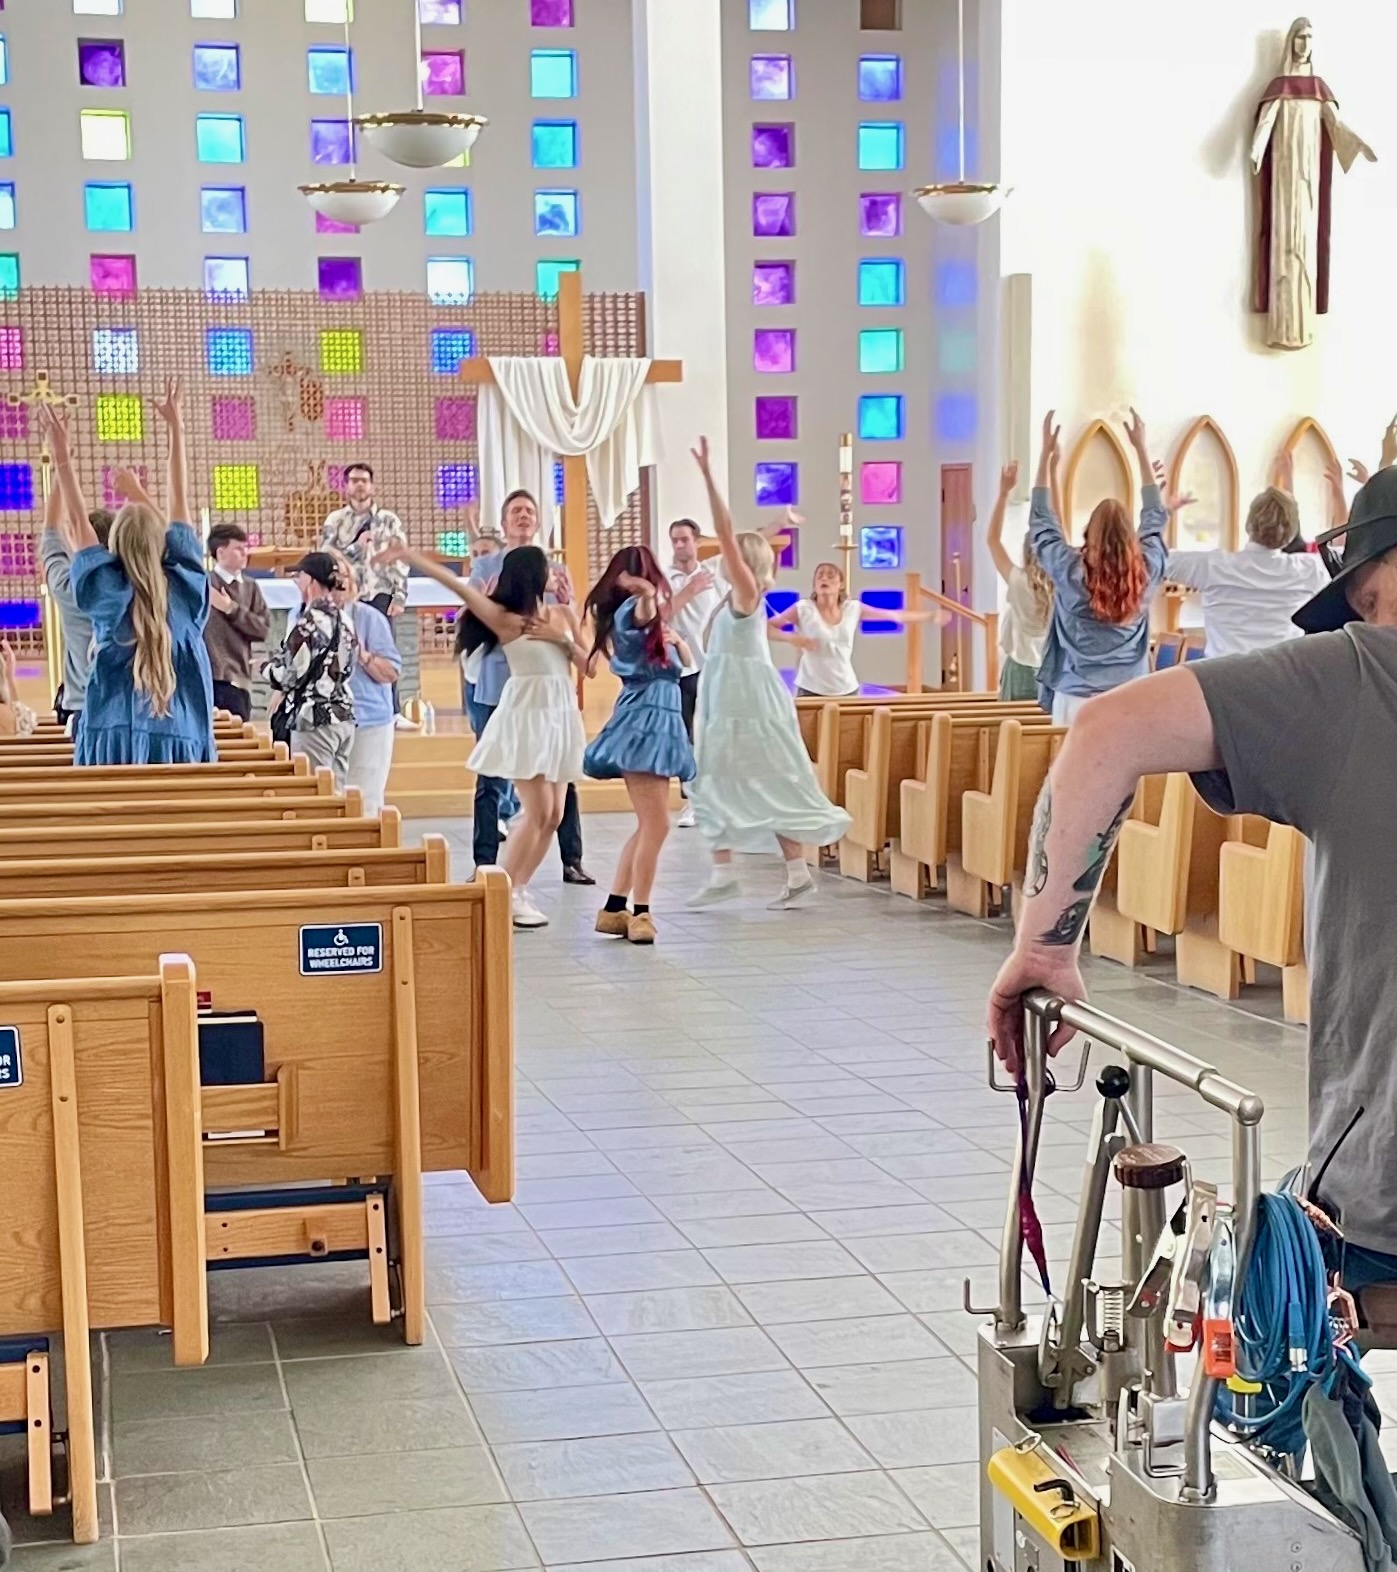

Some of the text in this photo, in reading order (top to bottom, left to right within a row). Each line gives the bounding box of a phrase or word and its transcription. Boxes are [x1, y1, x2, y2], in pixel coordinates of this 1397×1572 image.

[308, 946, 375, 957] RESERVED FOR
[309, 957, 374, 968] WHEELCHAIRS
